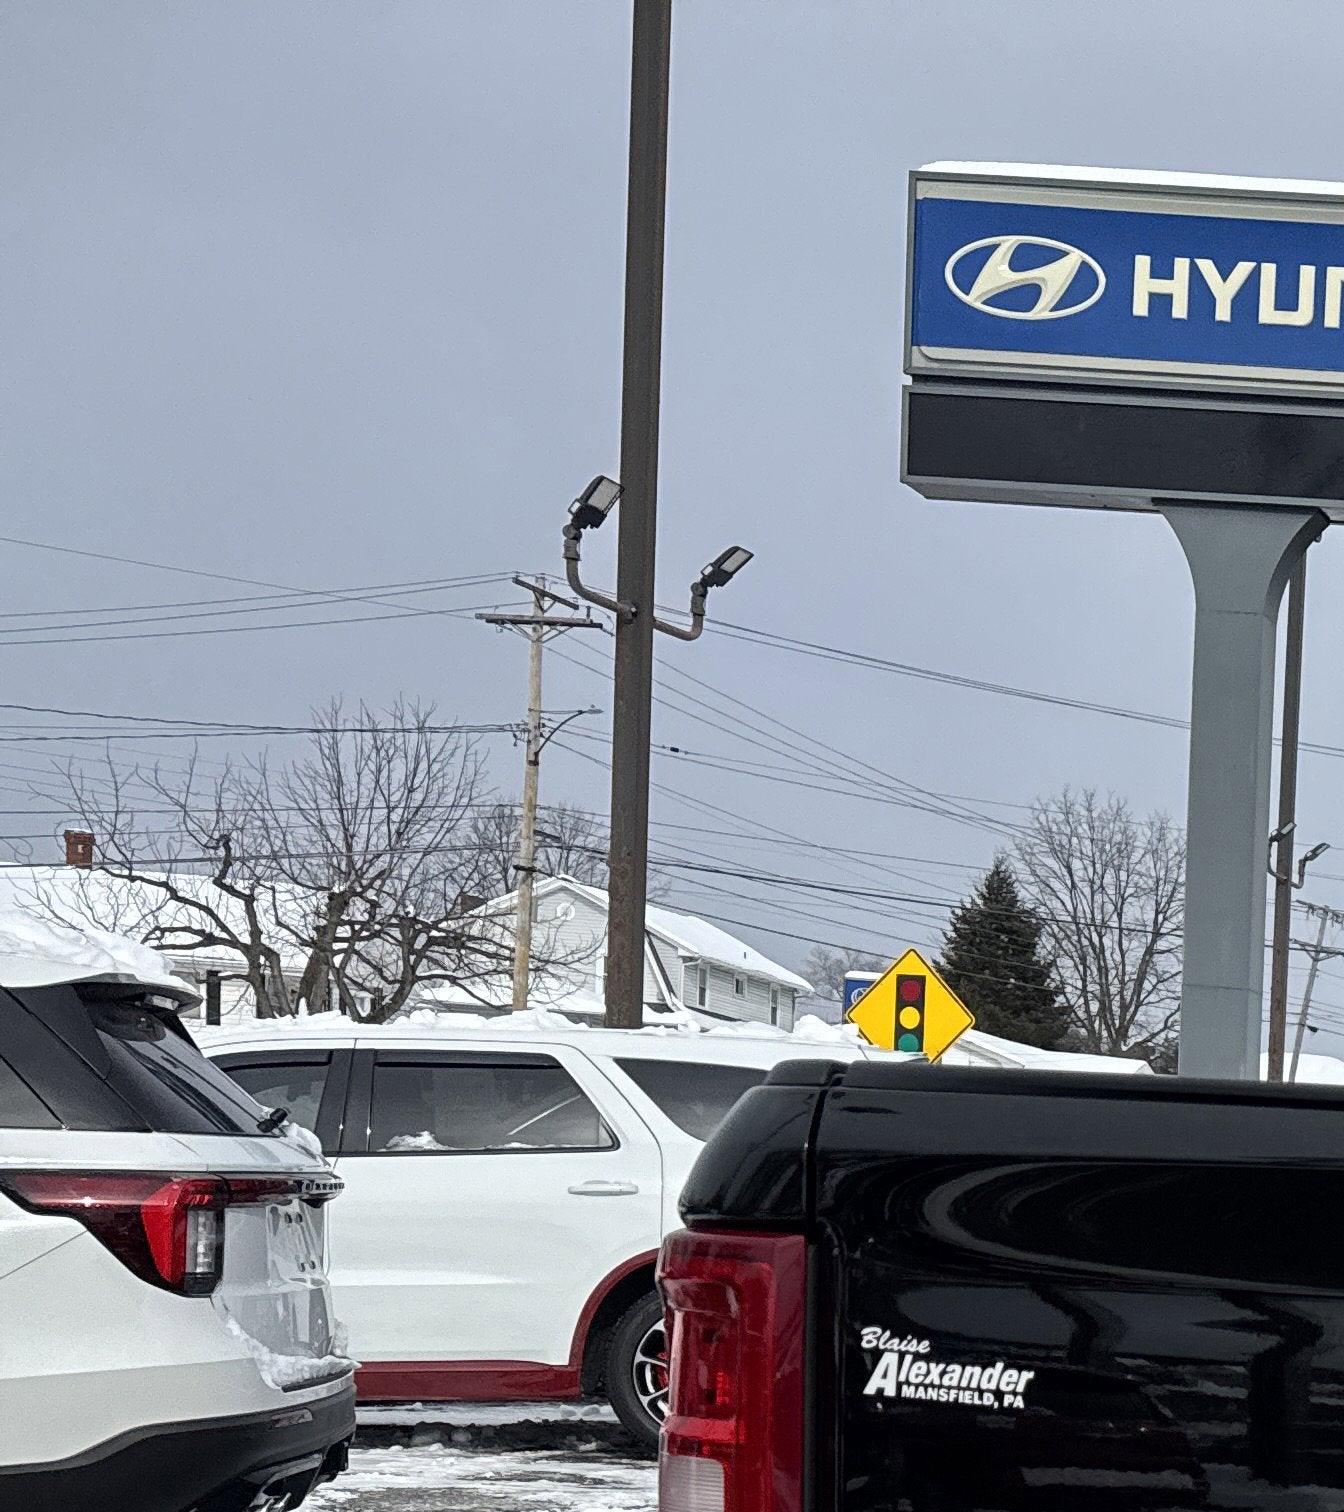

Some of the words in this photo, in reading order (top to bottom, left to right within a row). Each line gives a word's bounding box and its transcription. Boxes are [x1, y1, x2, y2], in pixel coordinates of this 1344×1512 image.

[860, 1326, 931, 1353] Blaise
[862, 1351, 1035, 1397] Alexander
[901, 1384, 998, 1409] MANSFIELD,
[1002, 1394, 1025, 1409] PA
